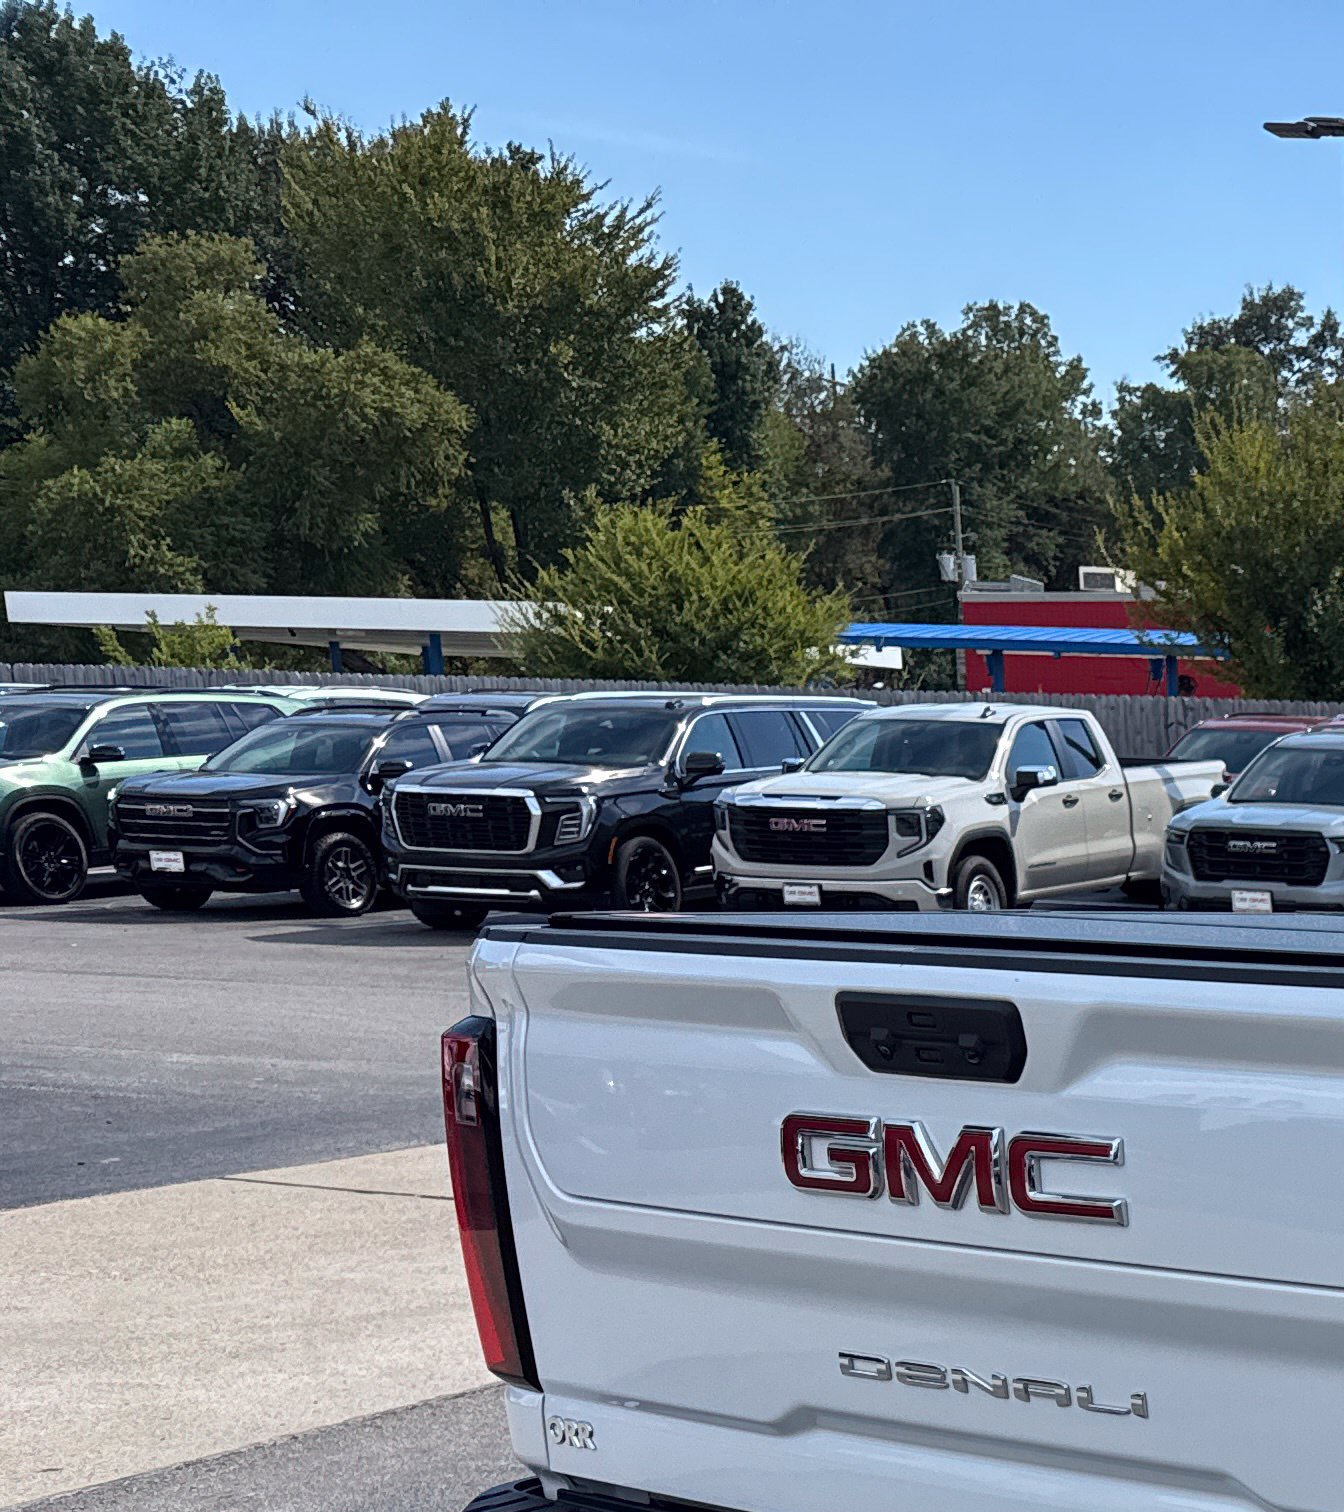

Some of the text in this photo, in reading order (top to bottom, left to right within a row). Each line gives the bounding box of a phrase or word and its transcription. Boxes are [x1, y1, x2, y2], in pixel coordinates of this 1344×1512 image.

[145, 804, 193, 817] GMC
[427, 802, 484, 817] GMC
[769, 818, 827, 832] GMC
[1228, 841, 1278, 854] GMC
[780, 1110, 1129, 1227] GMC
[838, 1351, 1149, 1418] DENALI
[547, 1415, 597, 1450] ORR
